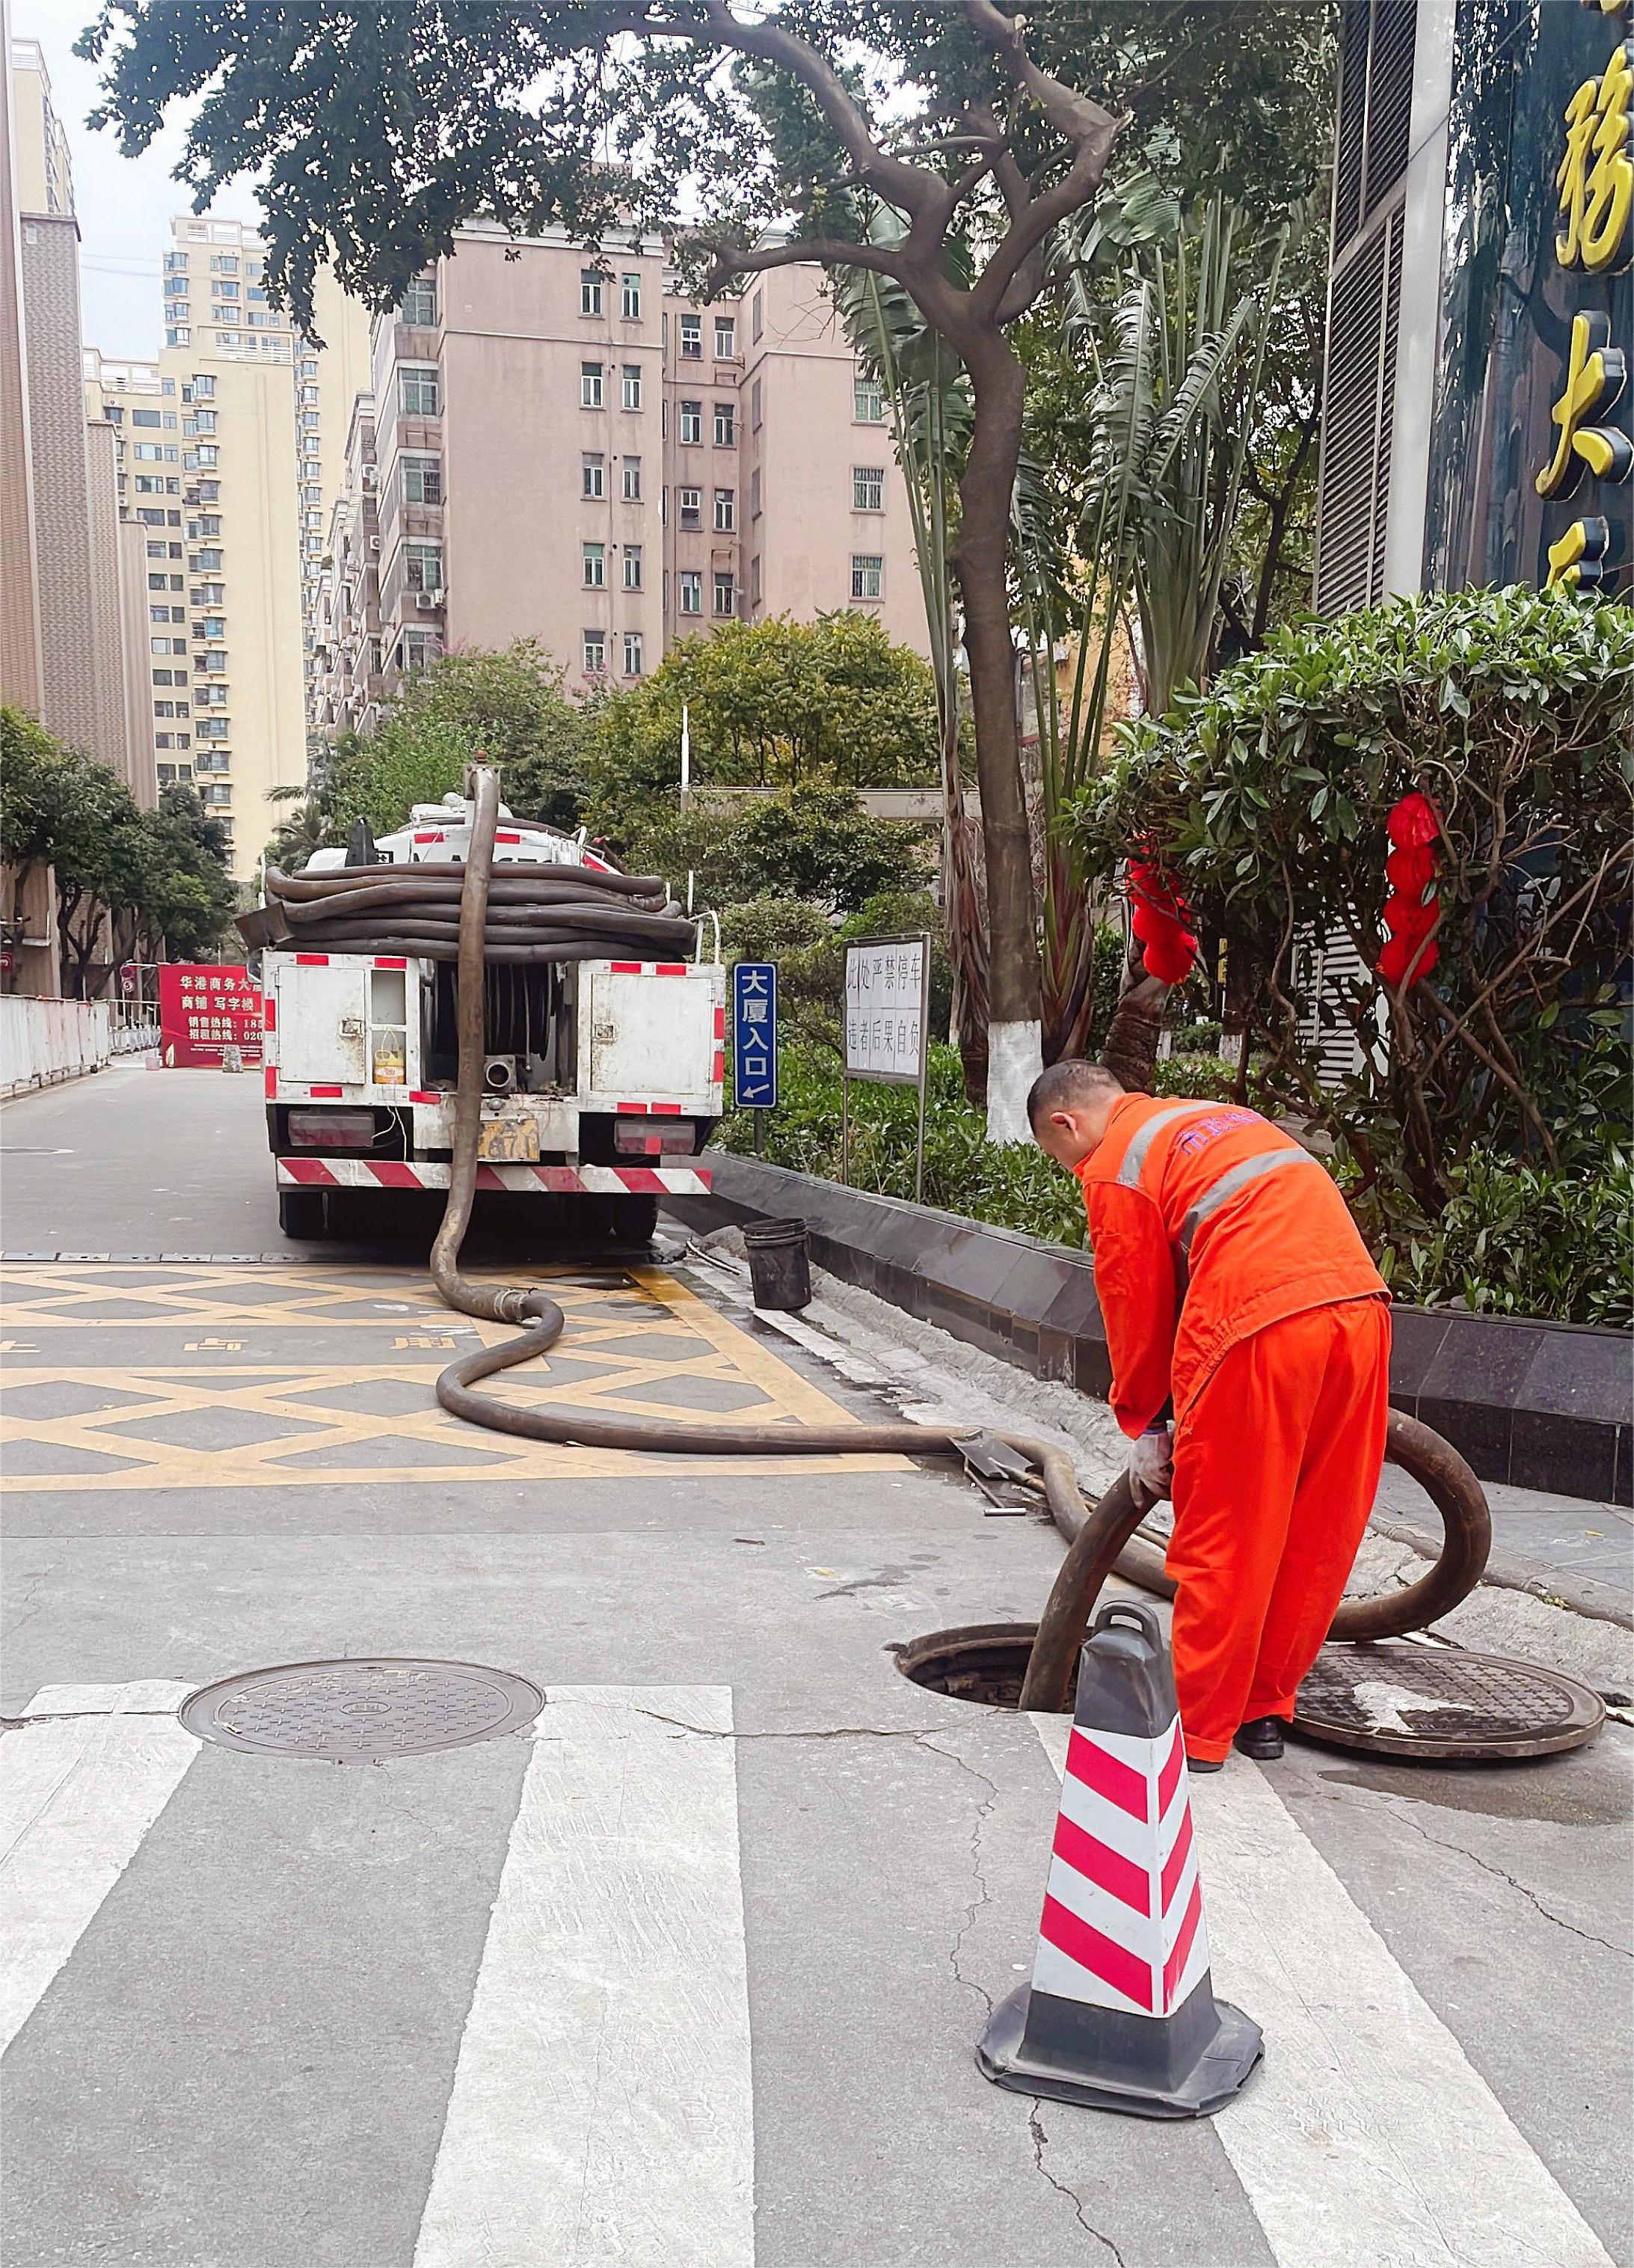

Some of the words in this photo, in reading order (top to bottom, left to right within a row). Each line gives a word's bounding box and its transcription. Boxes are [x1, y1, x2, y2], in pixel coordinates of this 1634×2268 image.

[847, 953, 921, 990] 此处严禁停车
[214, 996, 254, 1011] 写字楼
[742, 970, 769, 1076] 大厦入口
